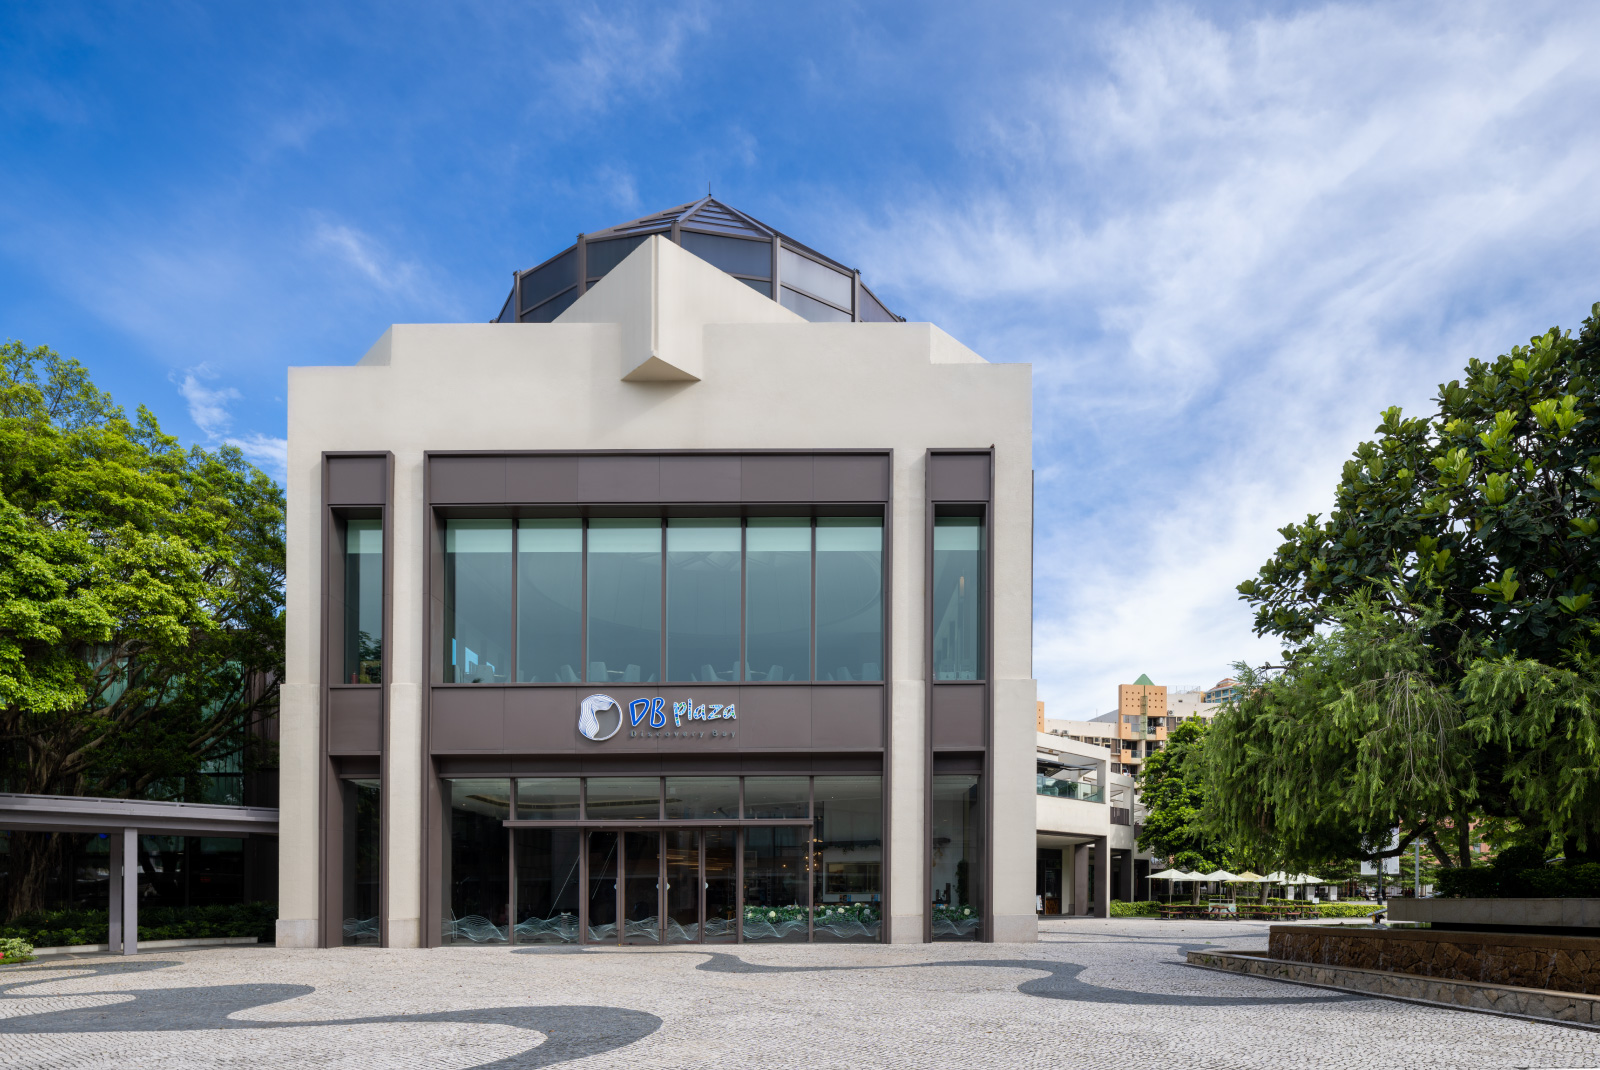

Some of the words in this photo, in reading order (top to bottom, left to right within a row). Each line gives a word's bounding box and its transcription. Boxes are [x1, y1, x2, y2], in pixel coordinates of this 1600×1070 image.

[629, 697, 666, 729] DB
[673, 698, 736, 727] plaza
[630, 730, 705, 738] Discovery
[712, 729, 736, 738] Bay
